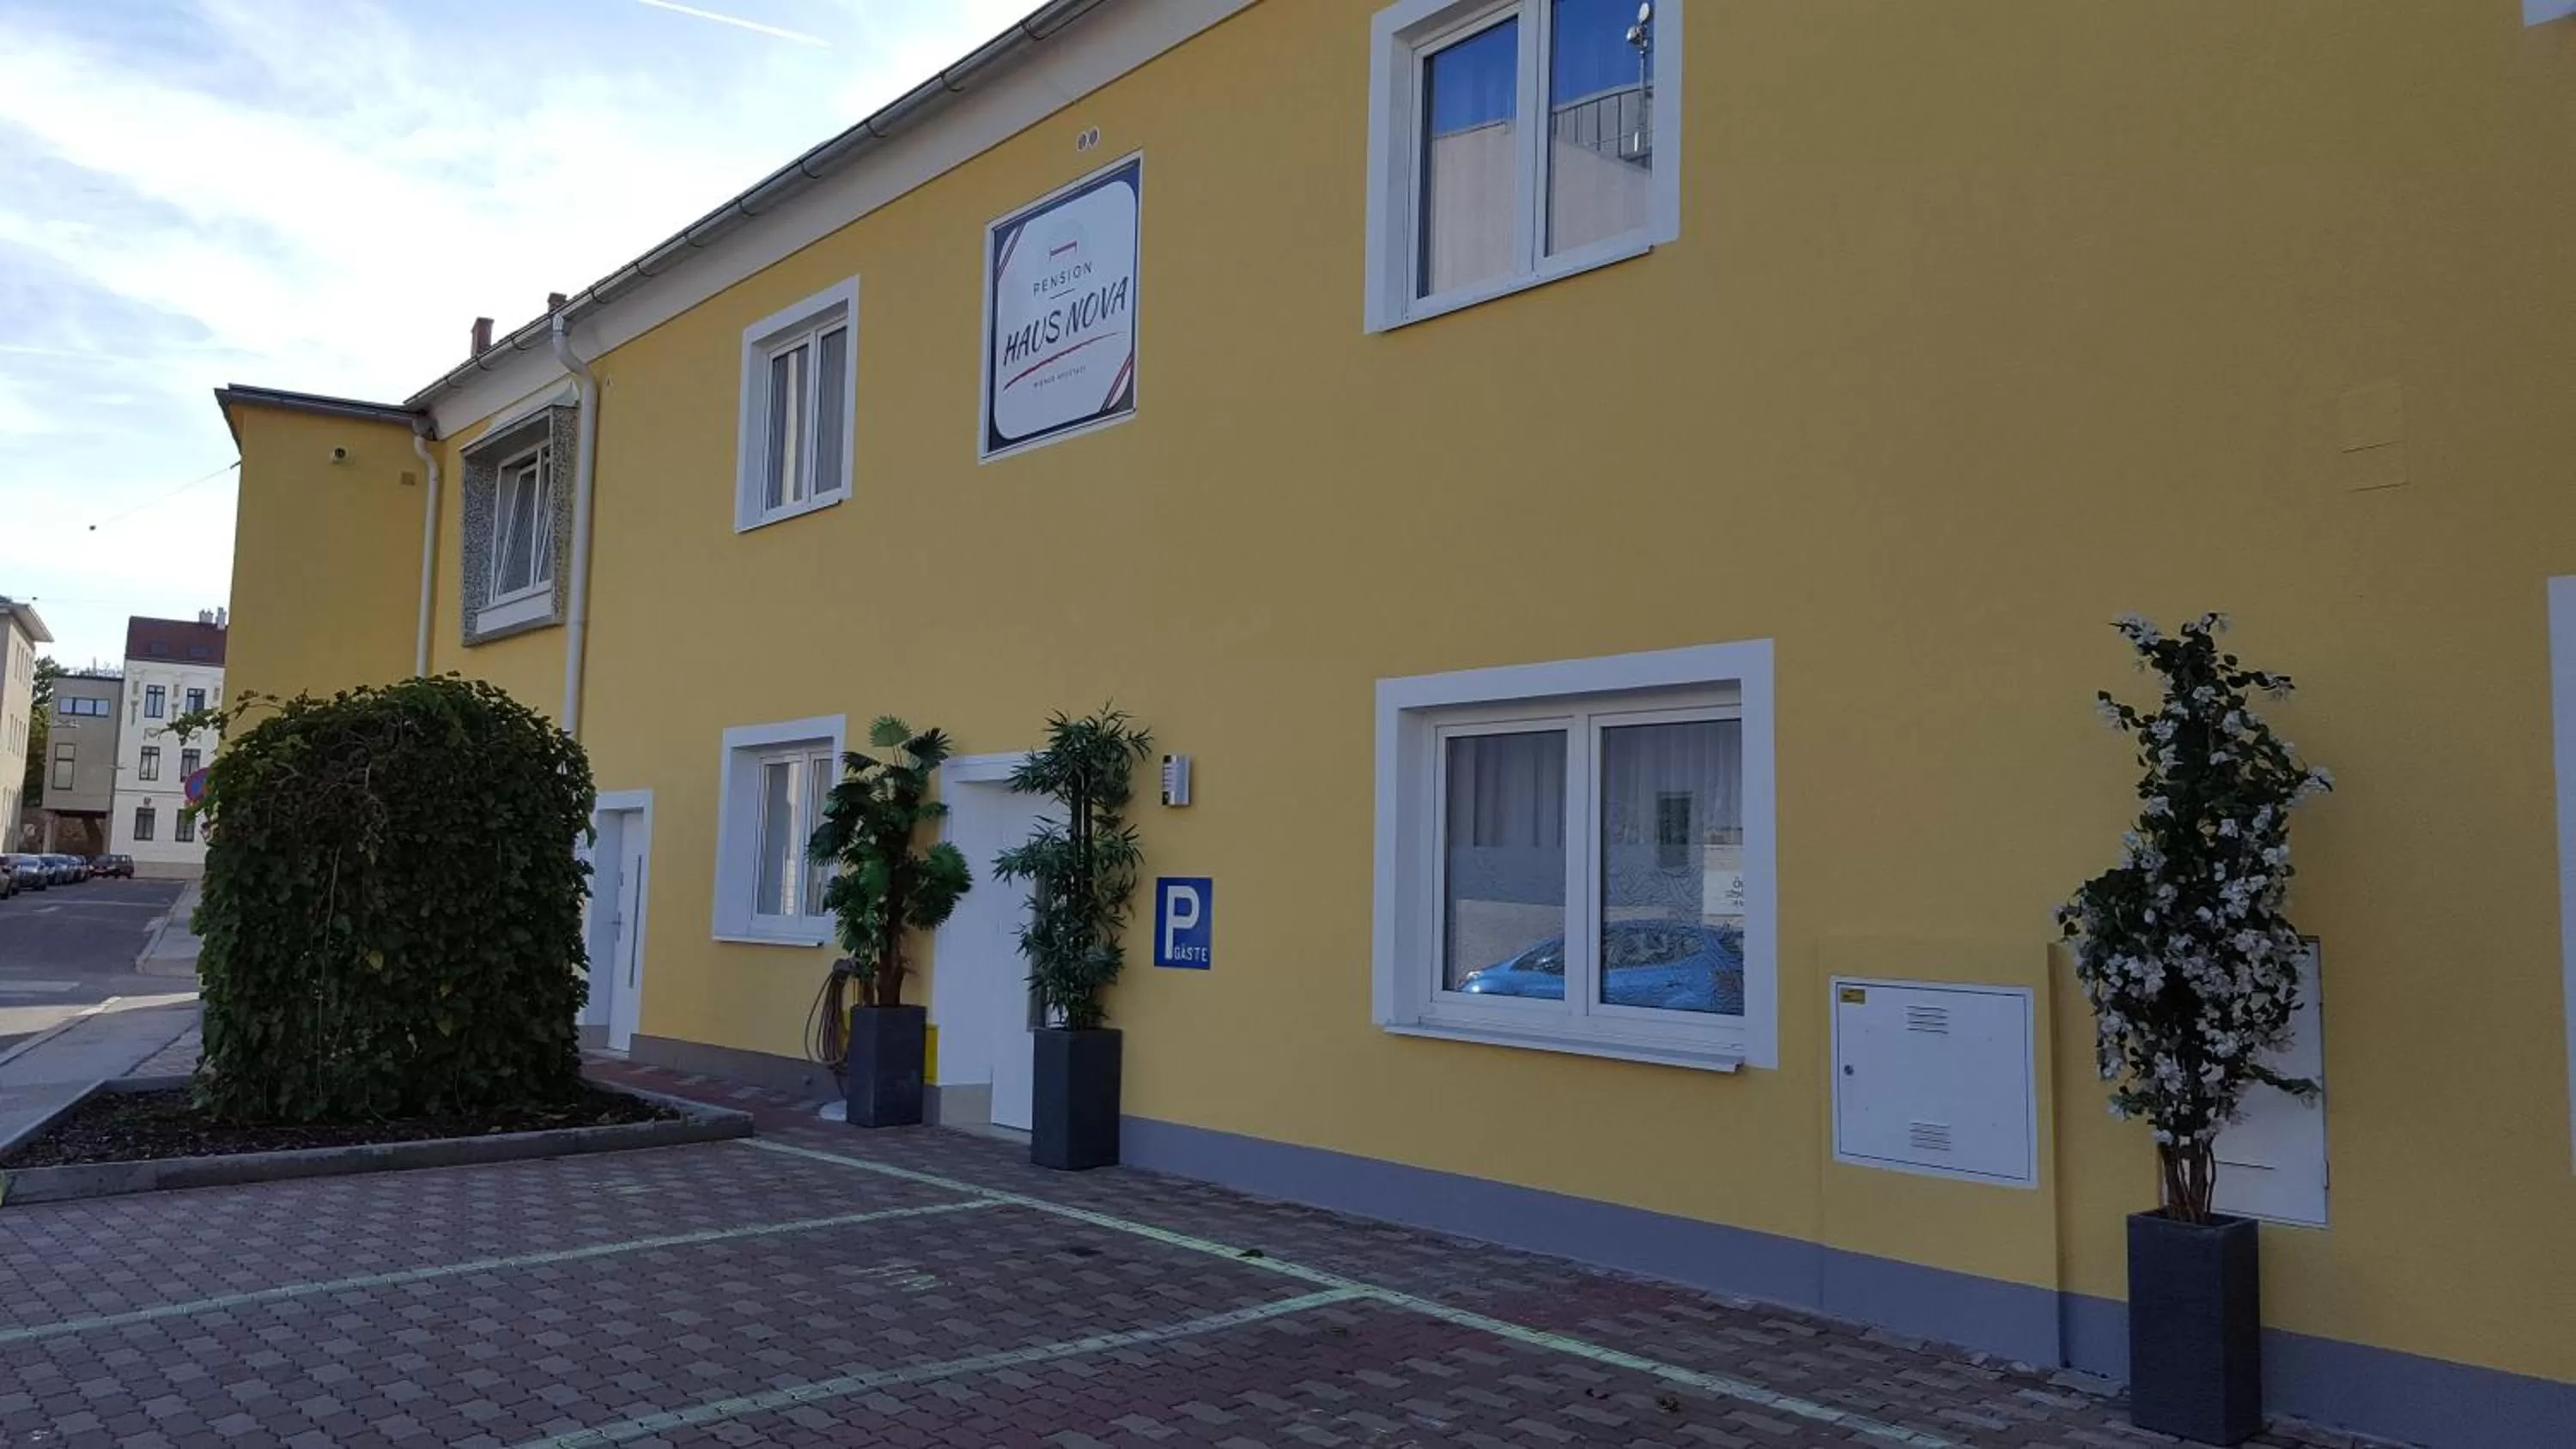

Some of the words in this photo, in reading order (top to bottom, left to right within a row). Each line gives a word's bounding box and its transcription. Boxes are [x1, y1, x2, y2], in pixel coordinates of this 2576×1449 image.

[1033, 261, 1092, 296] PENSION
[1003, 309, 1061, 367] HAUS
[1066, 276, 1129, 337] NOVA
[1164, 885, 1200, 960] P
[1174, 943, 1209, 962] GÄSTE
